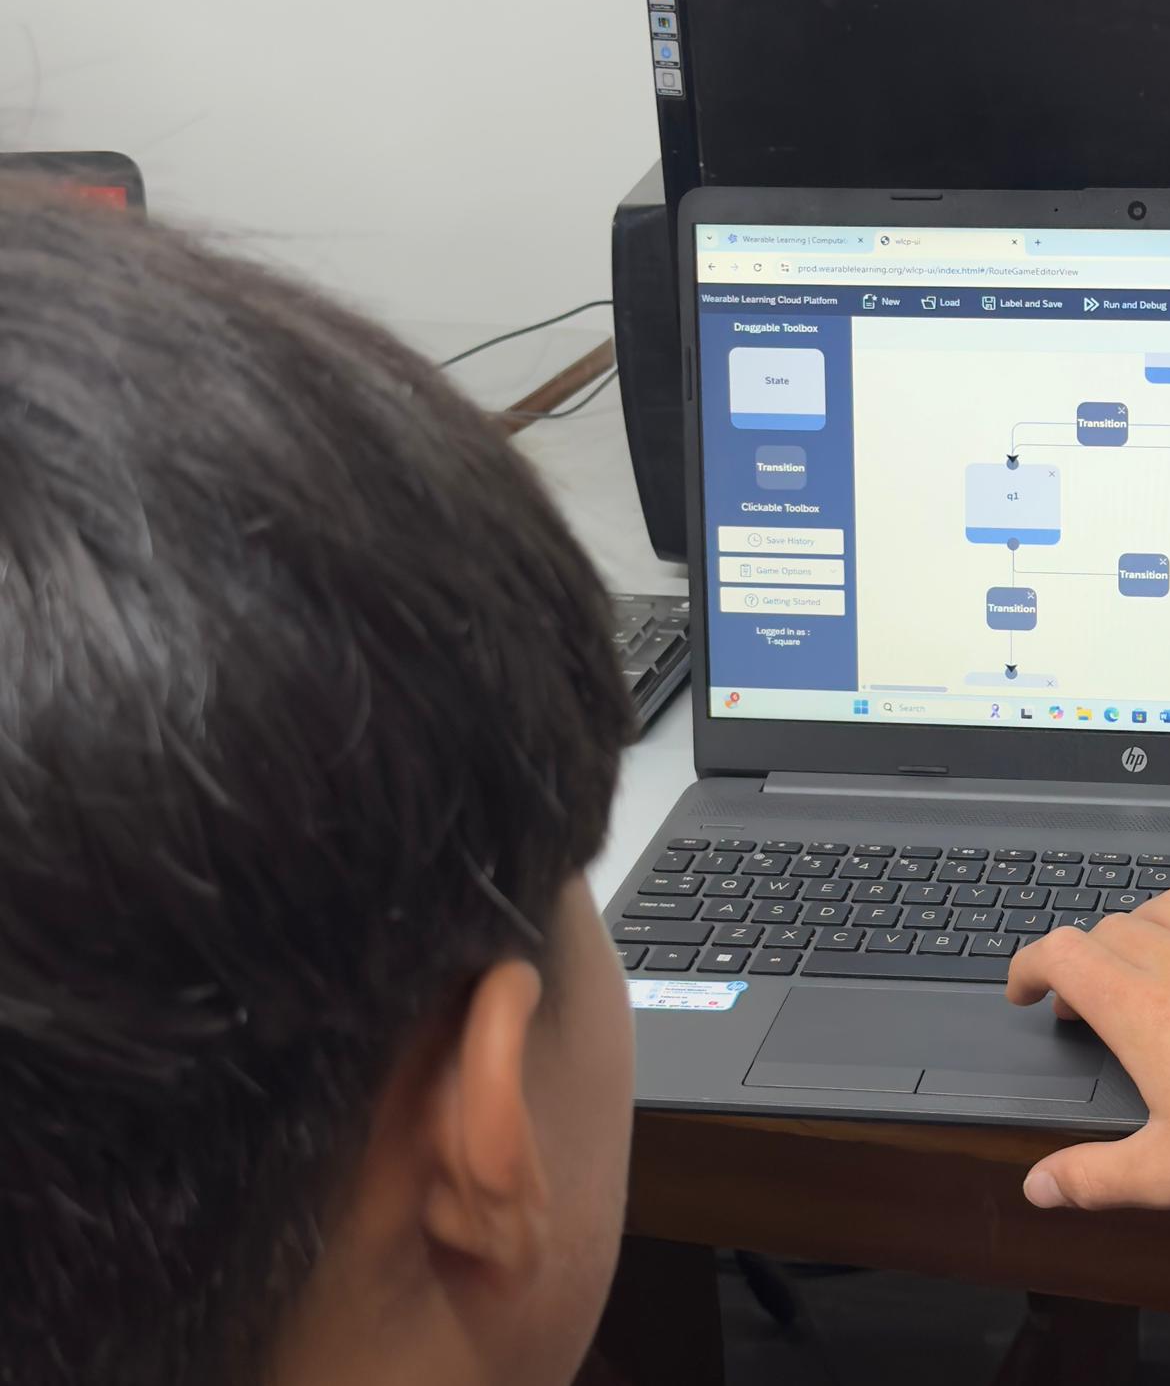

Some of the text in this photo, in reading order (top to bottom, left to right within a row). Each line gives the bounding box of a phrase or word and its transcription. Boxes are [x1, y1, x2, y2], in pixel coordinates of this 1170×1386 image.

[742, 235, 775, 244] Wearable
[776, 236, 806, 245] Learning
[701, 294, 838, 306] Wearable Learning Cloud Platform
[881, 297, 900, 306] New
[939, 298, 961, 307] Load
[1000, 299, 1063, 309] Label and Save
[1103, 300, 1168, 312] Run and Debug
[734, 323, 819, 334] Draggable Toolbox
[765, 376, 790, 386] State
[1077, 418, 1127, 429] Transition
[756, 462, 805, 473] Transition
[741, 502, 820, 513] Clickable Toolbox
[766, 536, 815, 547] Save History
[756, 567, 812, 576] Game Options
[1118, 569, 1169, 580] Transition
[762, 597, 821, 607] Getting Started
[987, 603, 1036, 614] Transition
[756, 627, 785, 637] Logged
[787, 627, 795, 636] in
[767, 637, 801, 647] T-square
[899, 704, 926, 712] Search
[1121, 747, 1147, 773] hp
[761, 859, 773, 867] 2
[811, 860, 822, 868] 3
[859, 862, 869, 870] 4
[908, 864, 918, 872] 5
[1007, 867, 1017, 875] 7
[1055, 869, 1066, 877] 8
[1105, 871, 1116, 879] 9
[722, 880, 737, 889] Q
[769, 881, 789, 891] W
[821, 883, 833, 892] E
[869, 885, 884, 894] R
[922, 887, 934, 895] T
[972, 888, 984, 897] Y
[1020, 891, 1034, 900] U
[719, 904, 734, 913] A
[771, 905, 784, 914] S
[821, 907, 835, 916] D
[871, 909, 885, 918] F
[921, 911, 936, 920] G
[972, 913, 987, 922] H
[1025, 915, 1036, 924] J
[1074, 917, 1089, 926] K
[731, 928, 747, 938] Z
[782, 930, 797, 940] X
[833, 932, 848, 942] C
[886, 934, 901, 943] V
[936, 936, 949, 945] B
[987, 938, 1003, 948] N
